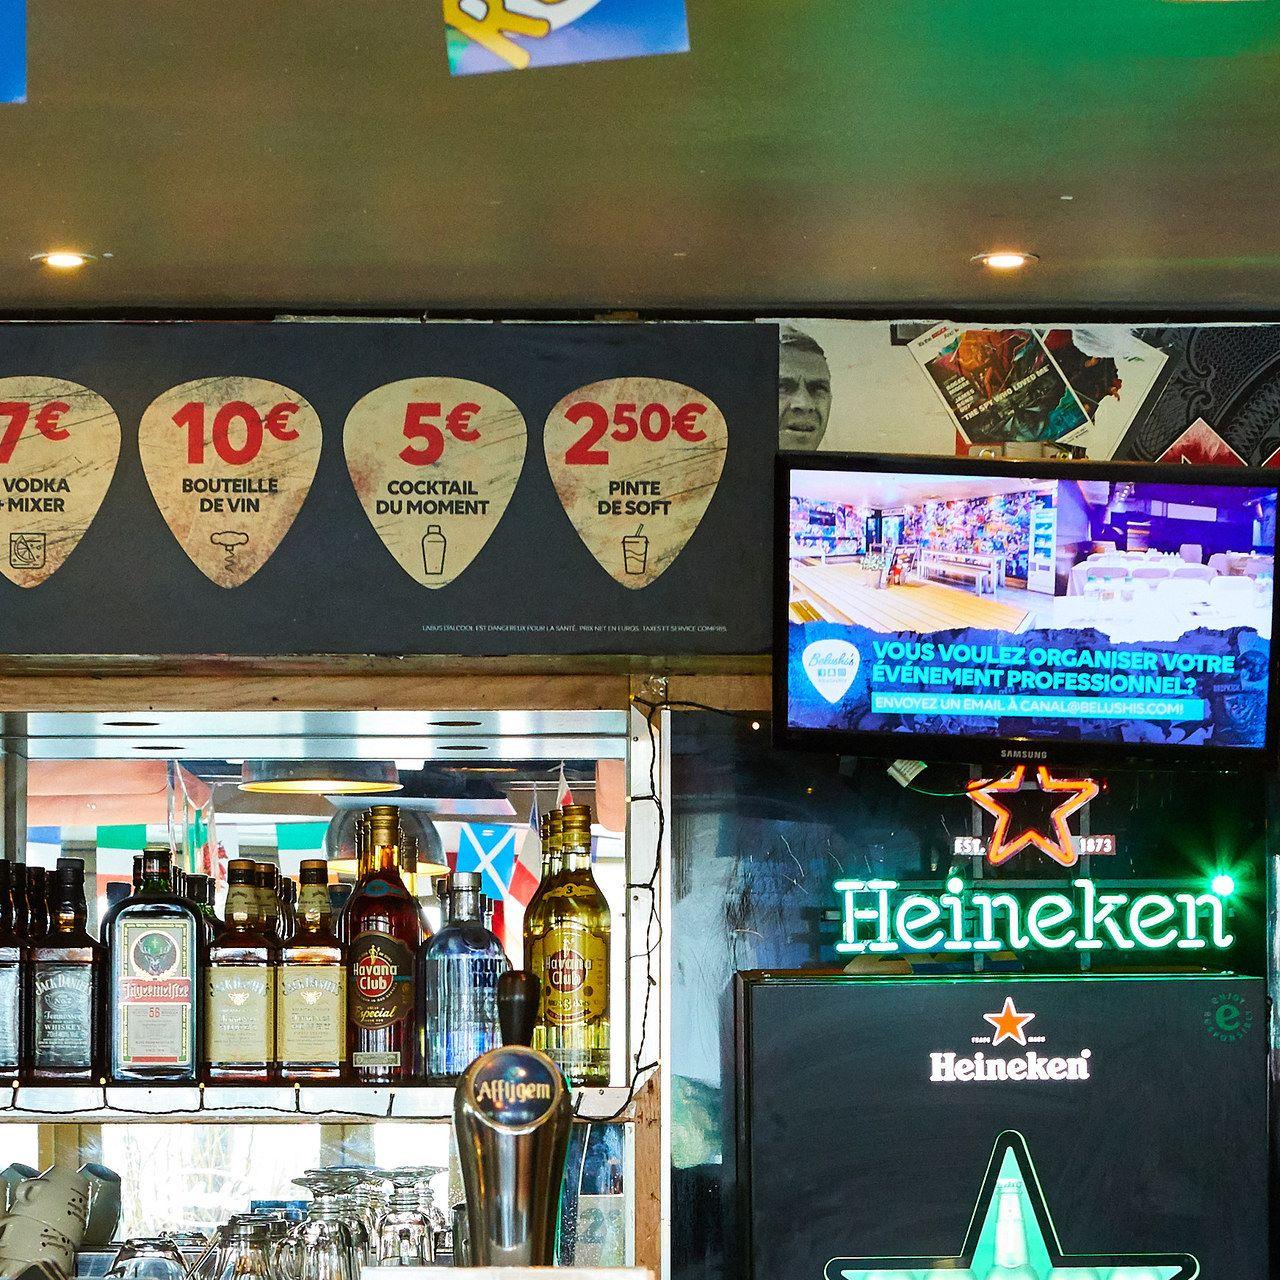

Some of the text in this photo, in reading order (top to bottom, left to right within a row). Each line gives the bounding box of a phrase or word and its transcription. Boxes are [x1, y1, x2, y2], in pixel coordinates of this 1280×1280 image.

[171, 400, 300, 466] 10€
[398, 401, 482, 466] 5€
[1, 478, 71, 494] VODKA
[181, 477, 279, 494] BOUTEILLE
[387, 480, 479, 496] COCKTAIL
[608, 480, 661, 497] PINTE
[7, 497, 65, 513] MIXER
[199, 497, 261, 514] DE VIN
[376, 499, 490, 515] DU MOMENT
[598, 500, 673, 516] DE SOFT
[872, 640, 1236, 675] VOUS VOULEZ ORGANISER VOTRE
[871, 662, 1198, 696] ÉVÉNEMENT PROFESSIONNEL?
[874, 696, 938, 711] ENVOYEZ
[939, 699, 961, 711] UN
[963, 698, 1005, 712] EMAIL
[999, 748, 1049, 760] SAMSUNG
[832, 876, 1235, 955] Heineken
[353, 963, 398, 979] Havana
[545, 957, 592, 974] Havana
[359, 975, 388, 991] Club
[551, 971, 581, 986] Club
[35, 979, 58, 996] JACK
[929, 1048, 1091, 1083] Heineken
